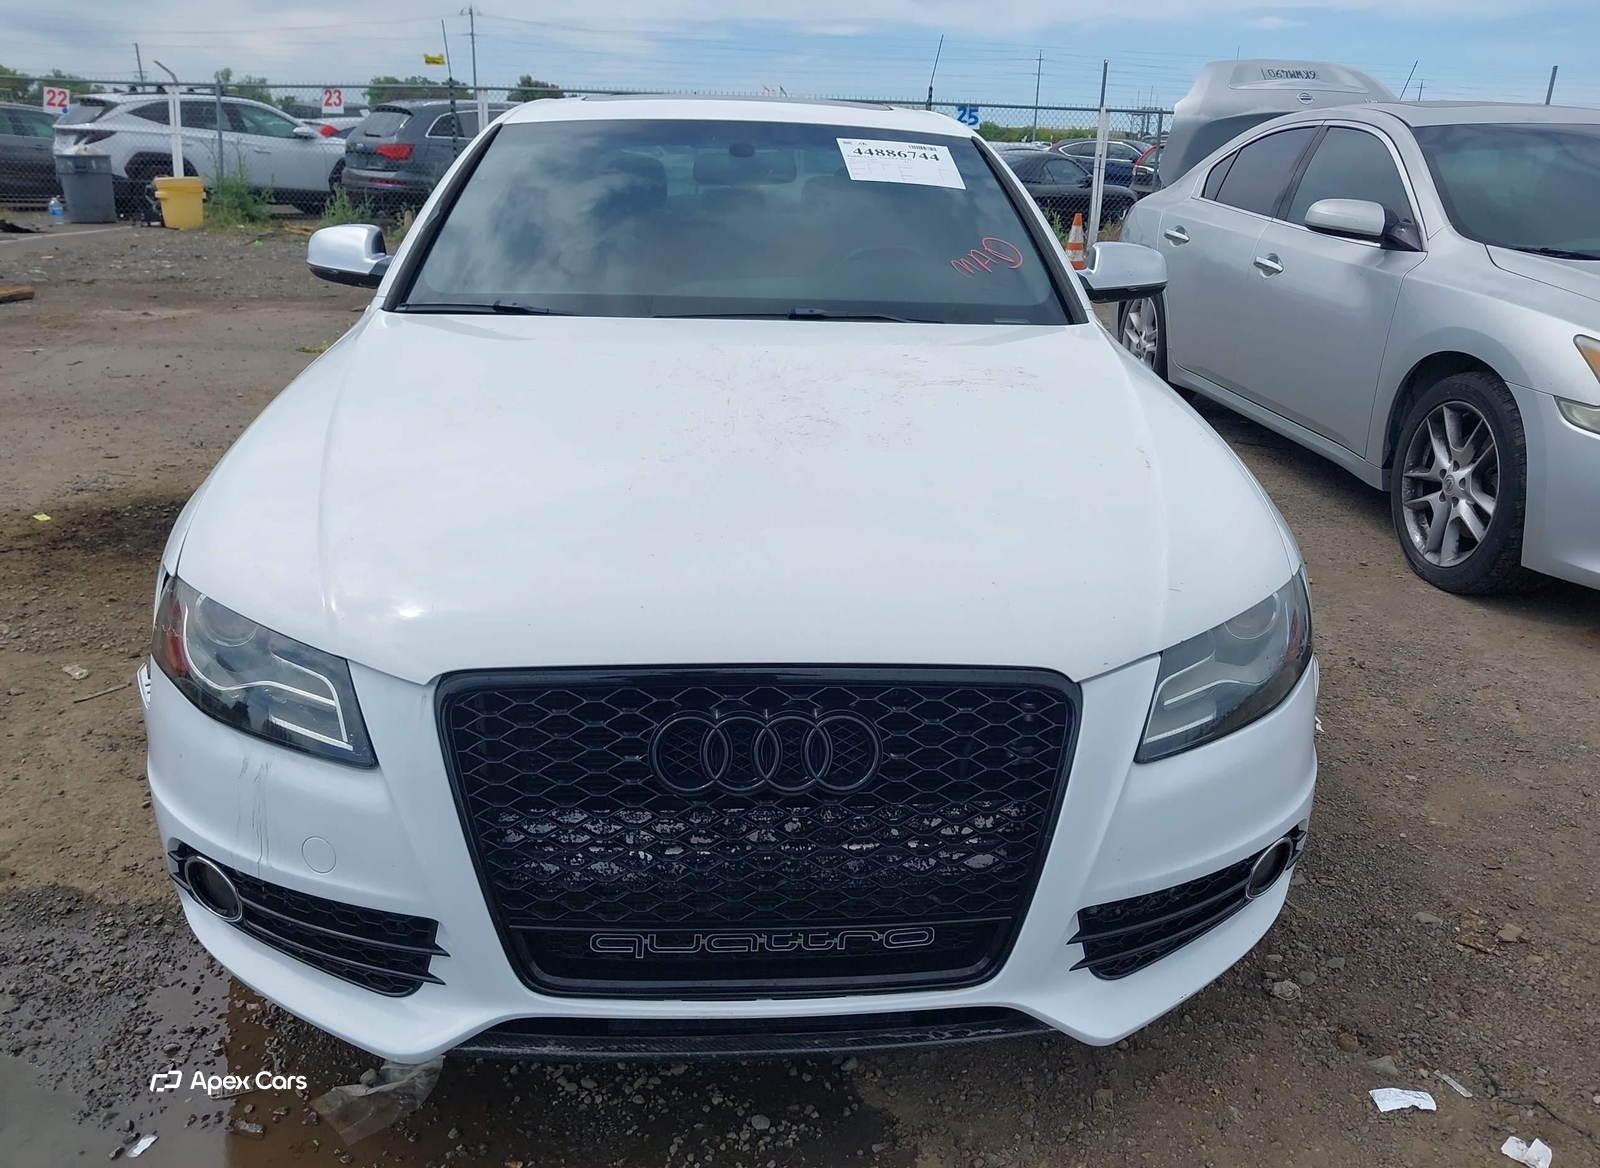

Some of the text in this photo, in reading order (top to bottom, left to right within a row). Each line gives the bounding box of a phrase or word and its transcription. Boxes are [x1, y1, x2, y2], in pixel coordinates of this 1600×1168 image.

[46, 89, 67, 107] 22
[324, 89, 342, 107] 23
[957, 104, 979, 126] 25
[852, 147, 940, 162] 44886744
[589, 926, 935, 959] quattro
